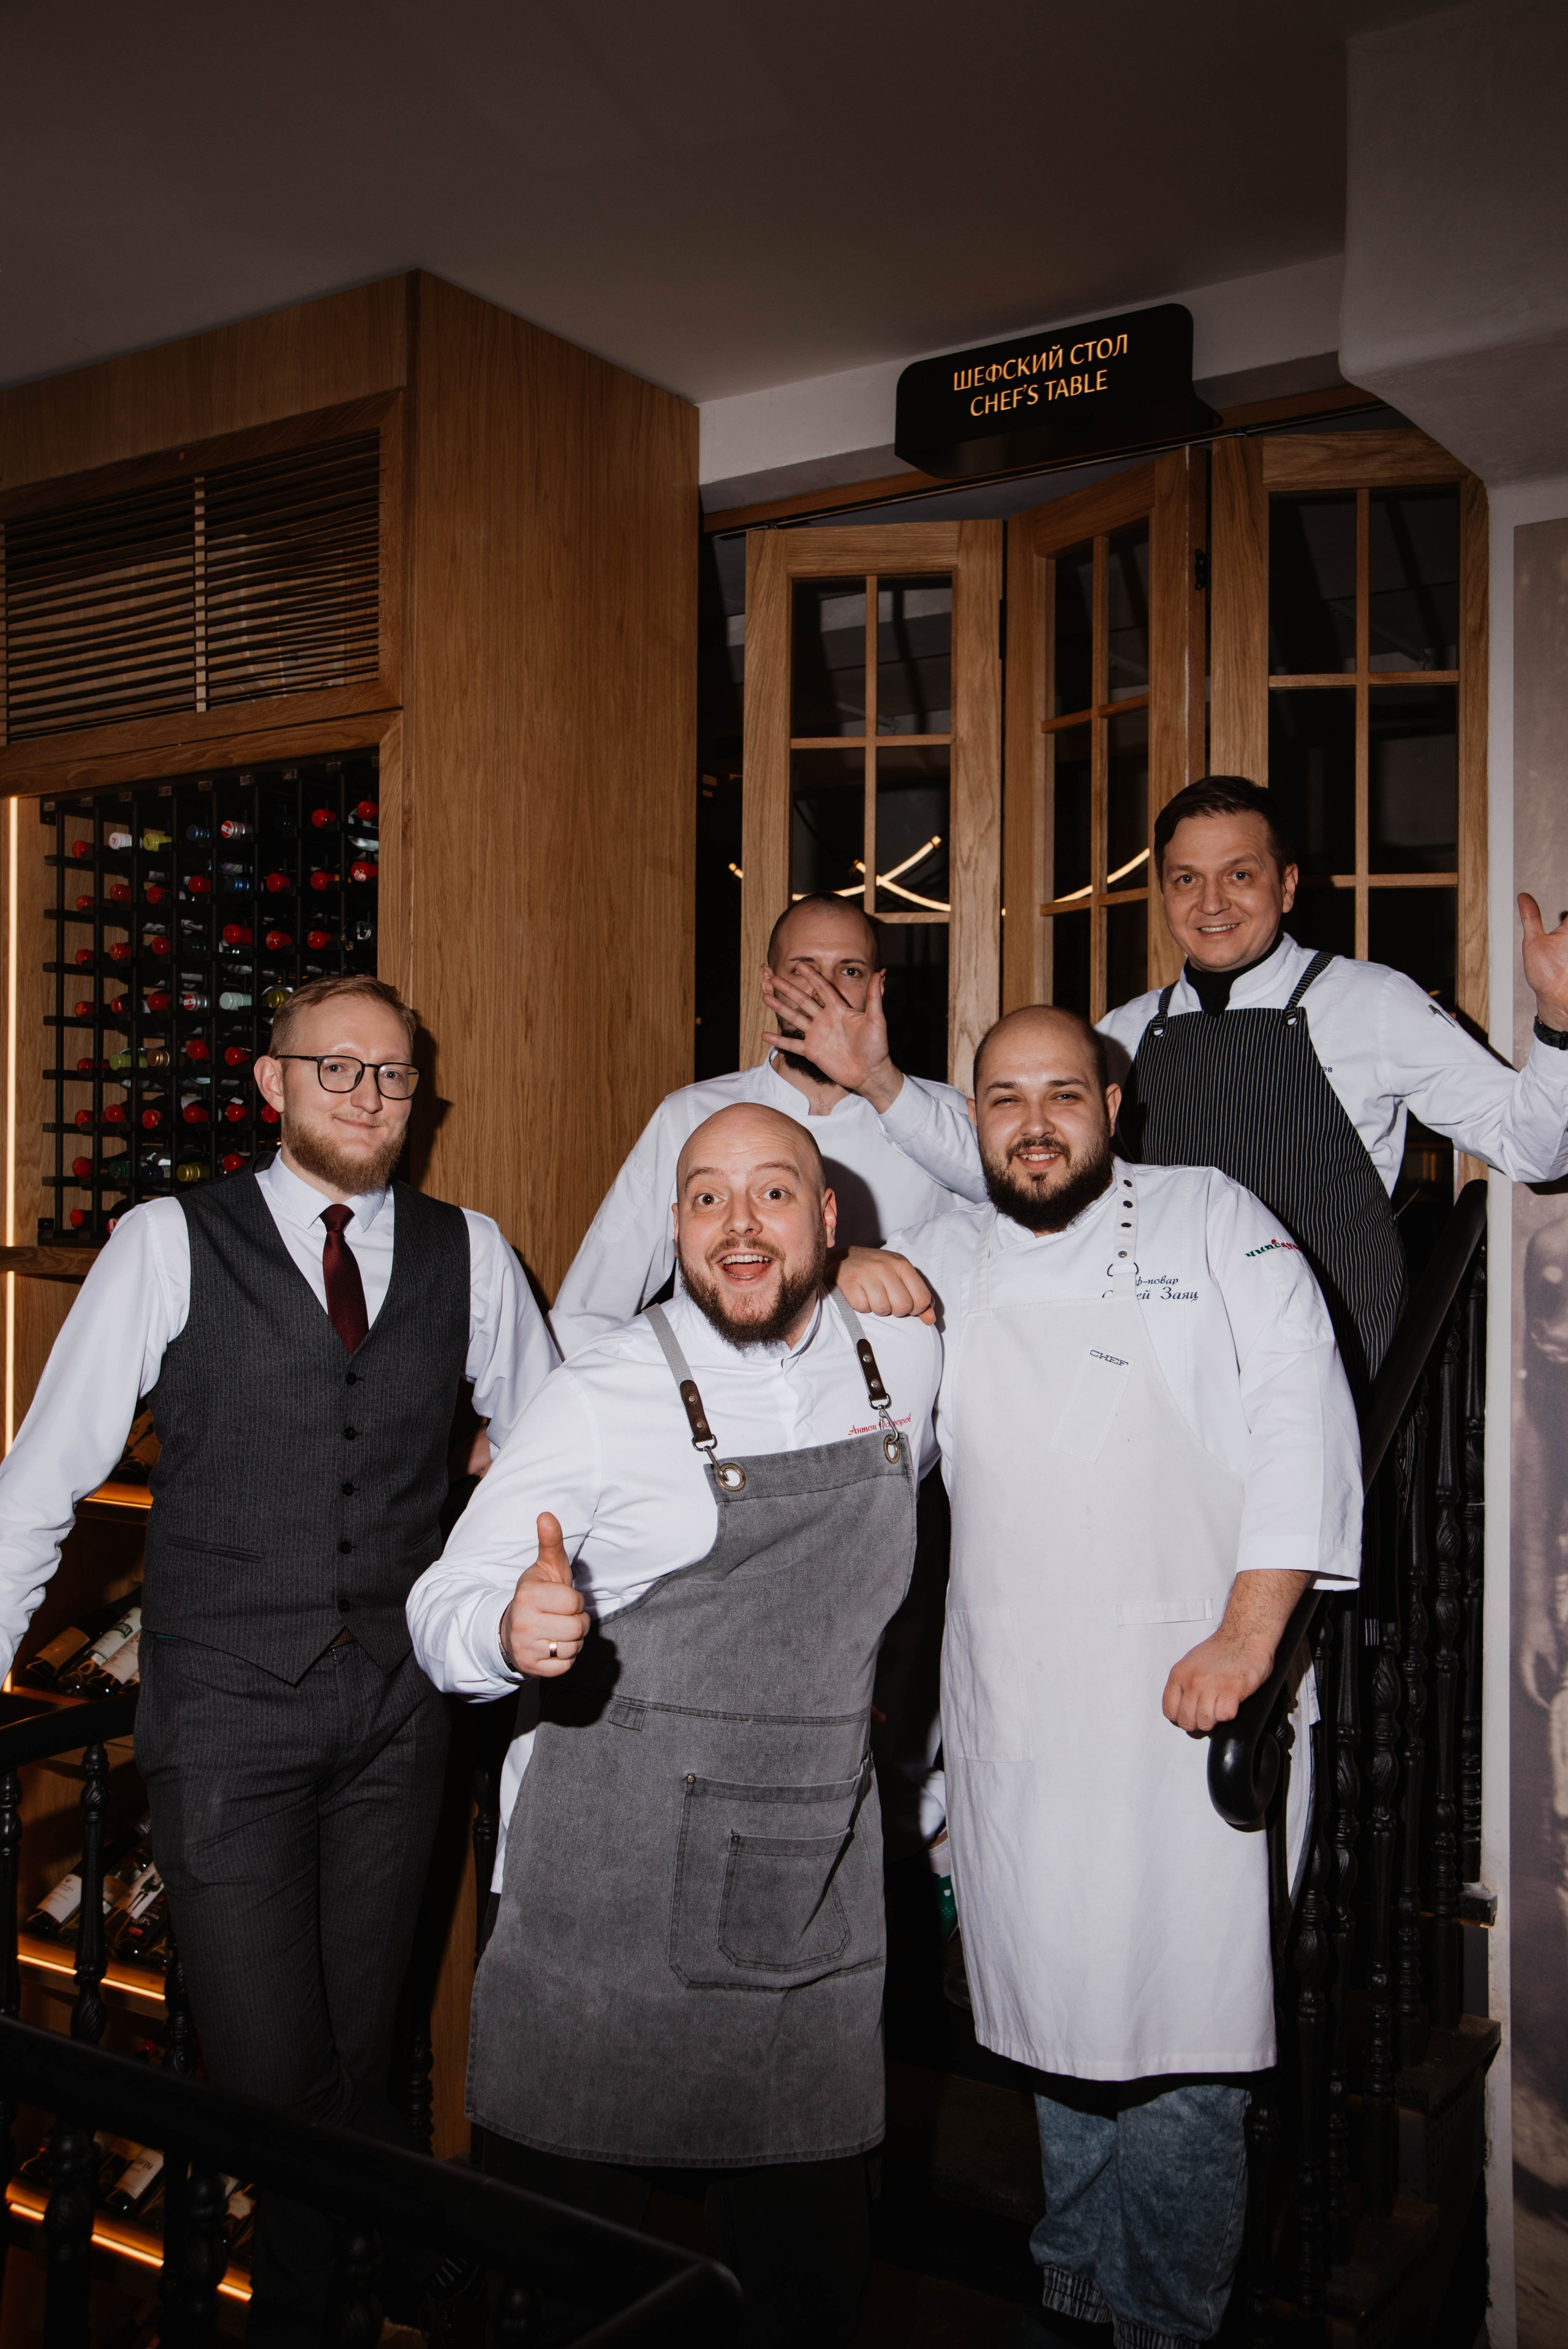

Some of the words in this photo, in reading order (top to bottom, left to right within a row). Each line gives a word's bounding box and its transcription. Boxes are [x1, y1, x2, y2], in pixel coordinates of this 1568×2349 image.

[954, 344, 1063, 391] ШЕФСКИЙ
[1070, 334, 1128, 365] СТОЛ
[970, 384, 1039, 417] CHEF'S
[1044, 369, 1108, 401] TABLE
[1161, 1286, 1199, 1302] Заяц
[1090, 1349, 1129, 1366] CHEF
[848, 1425, 877, 1436] Антон
[878, 1412, 911, 1428] Осроухов
